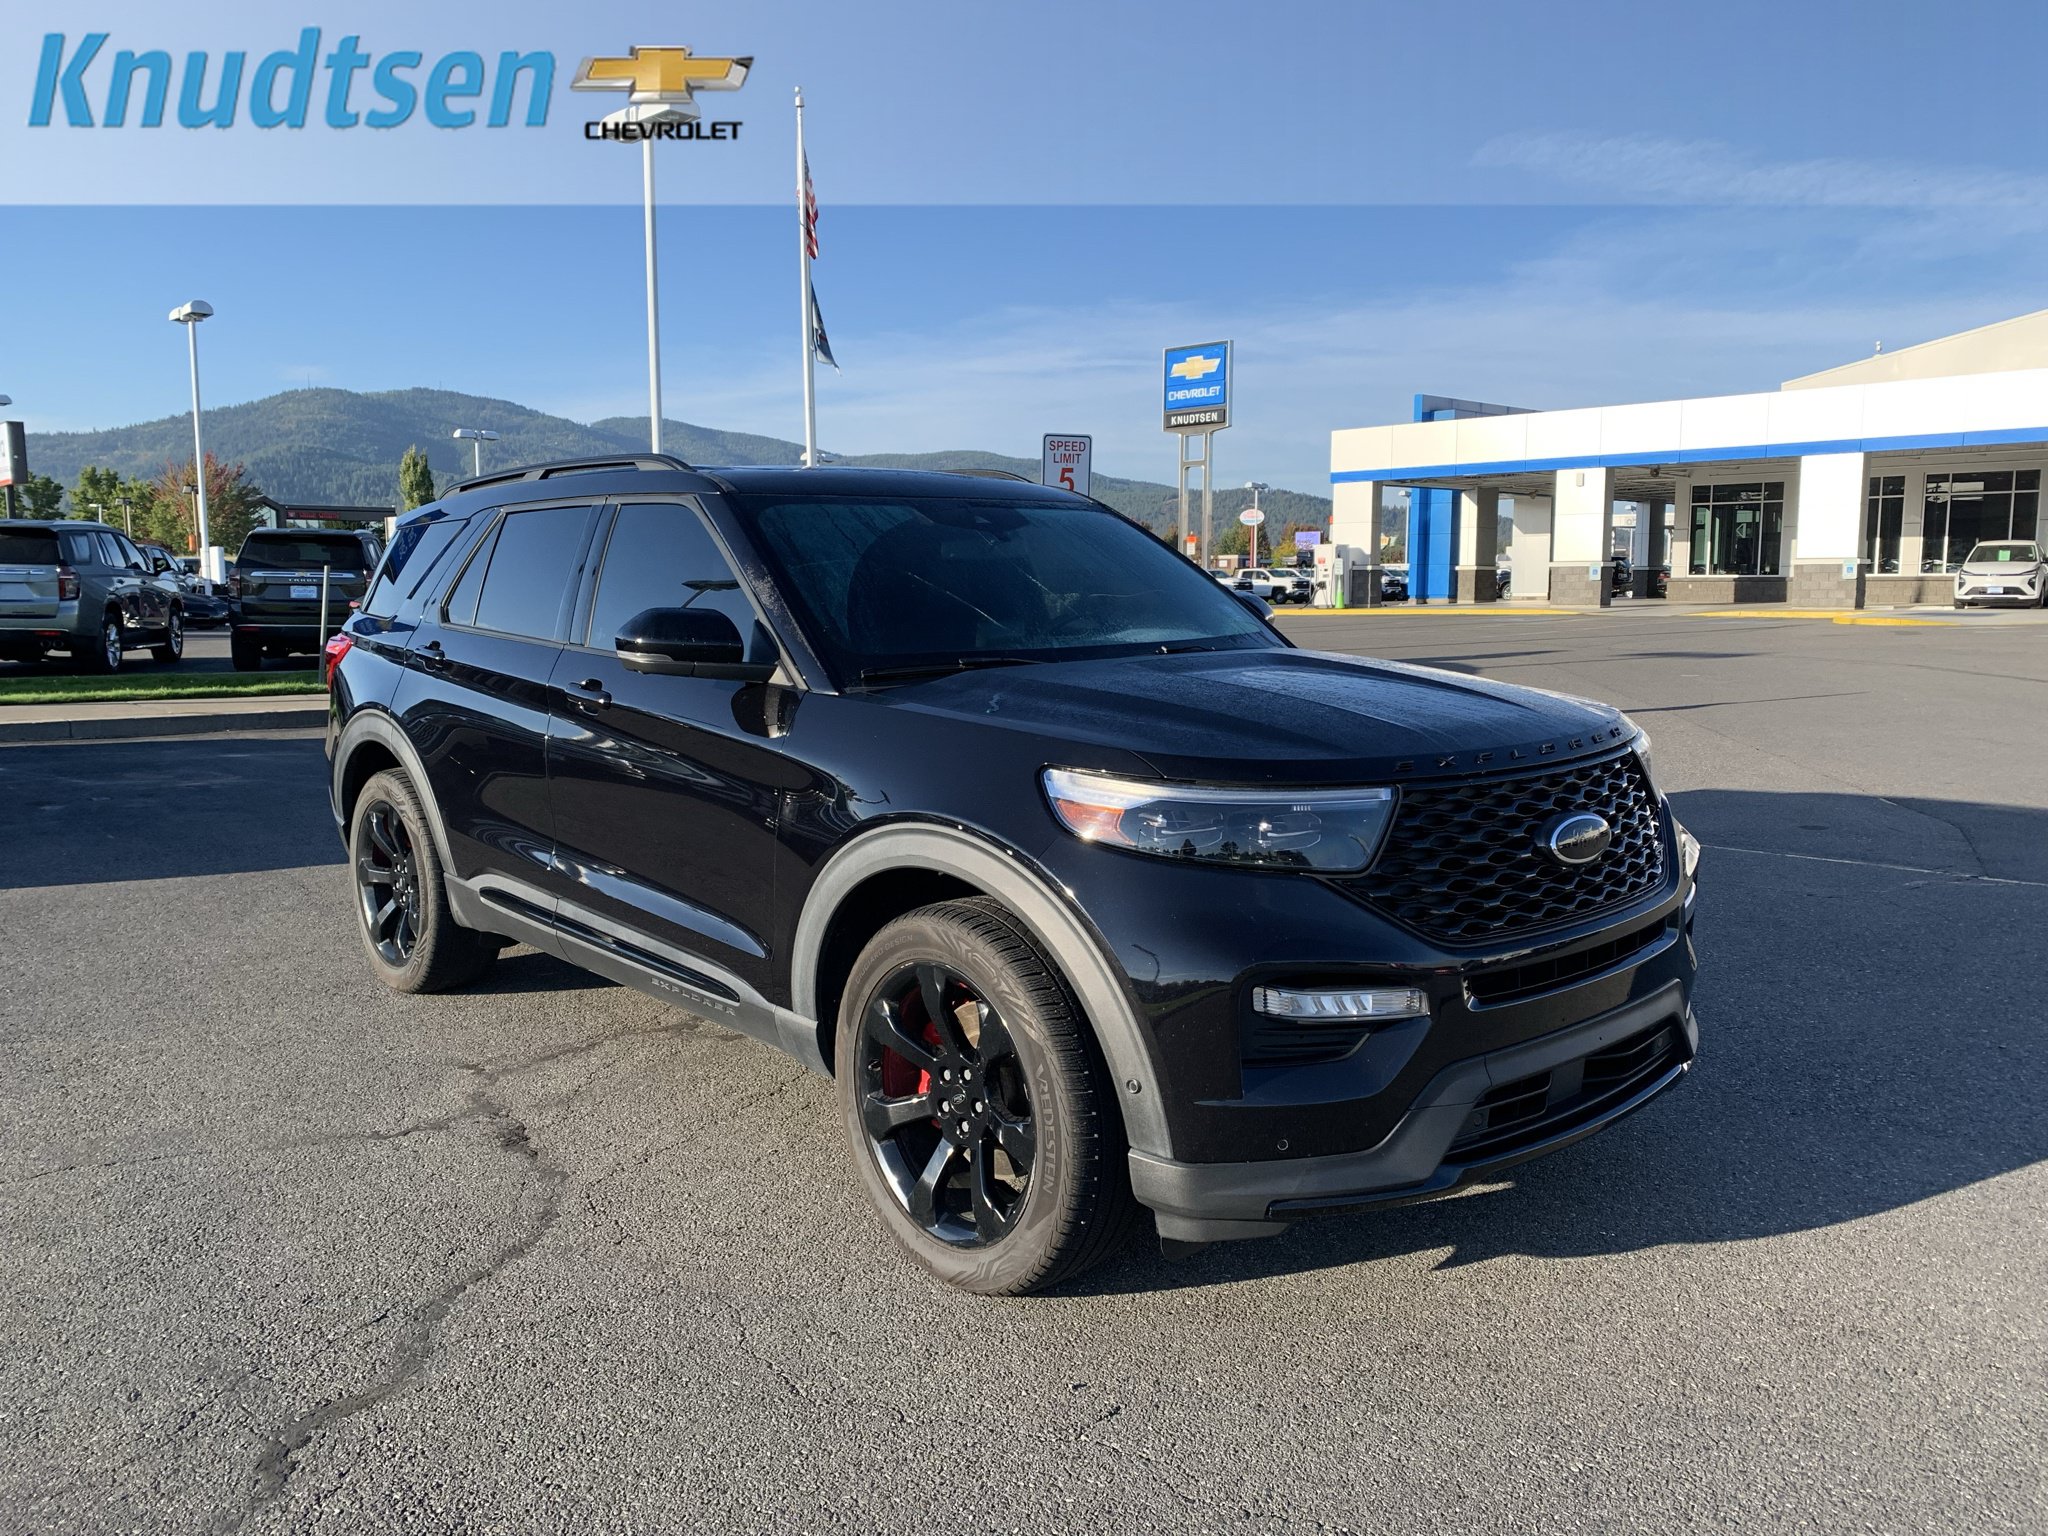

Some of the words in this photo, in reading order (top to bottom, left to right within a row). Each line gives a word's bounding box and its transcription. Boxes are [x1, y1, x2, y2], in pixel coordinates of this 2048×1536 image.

[1168, 385, 1221, 401] CHEVROLET
[1170, 411, 1218, 425] KNUDTSEN
[1049, 440, 1086, 452] SPEED
[1053, 453, 1082, 464] LIMIT
[1059, 467, 1075, 492] 5
[1393, 726, 1624, 772] EXPLORER
[651, 977, 737, 1017] EXPLORER
[1035, 1063, 1057, 1195] VREDESTEIN
